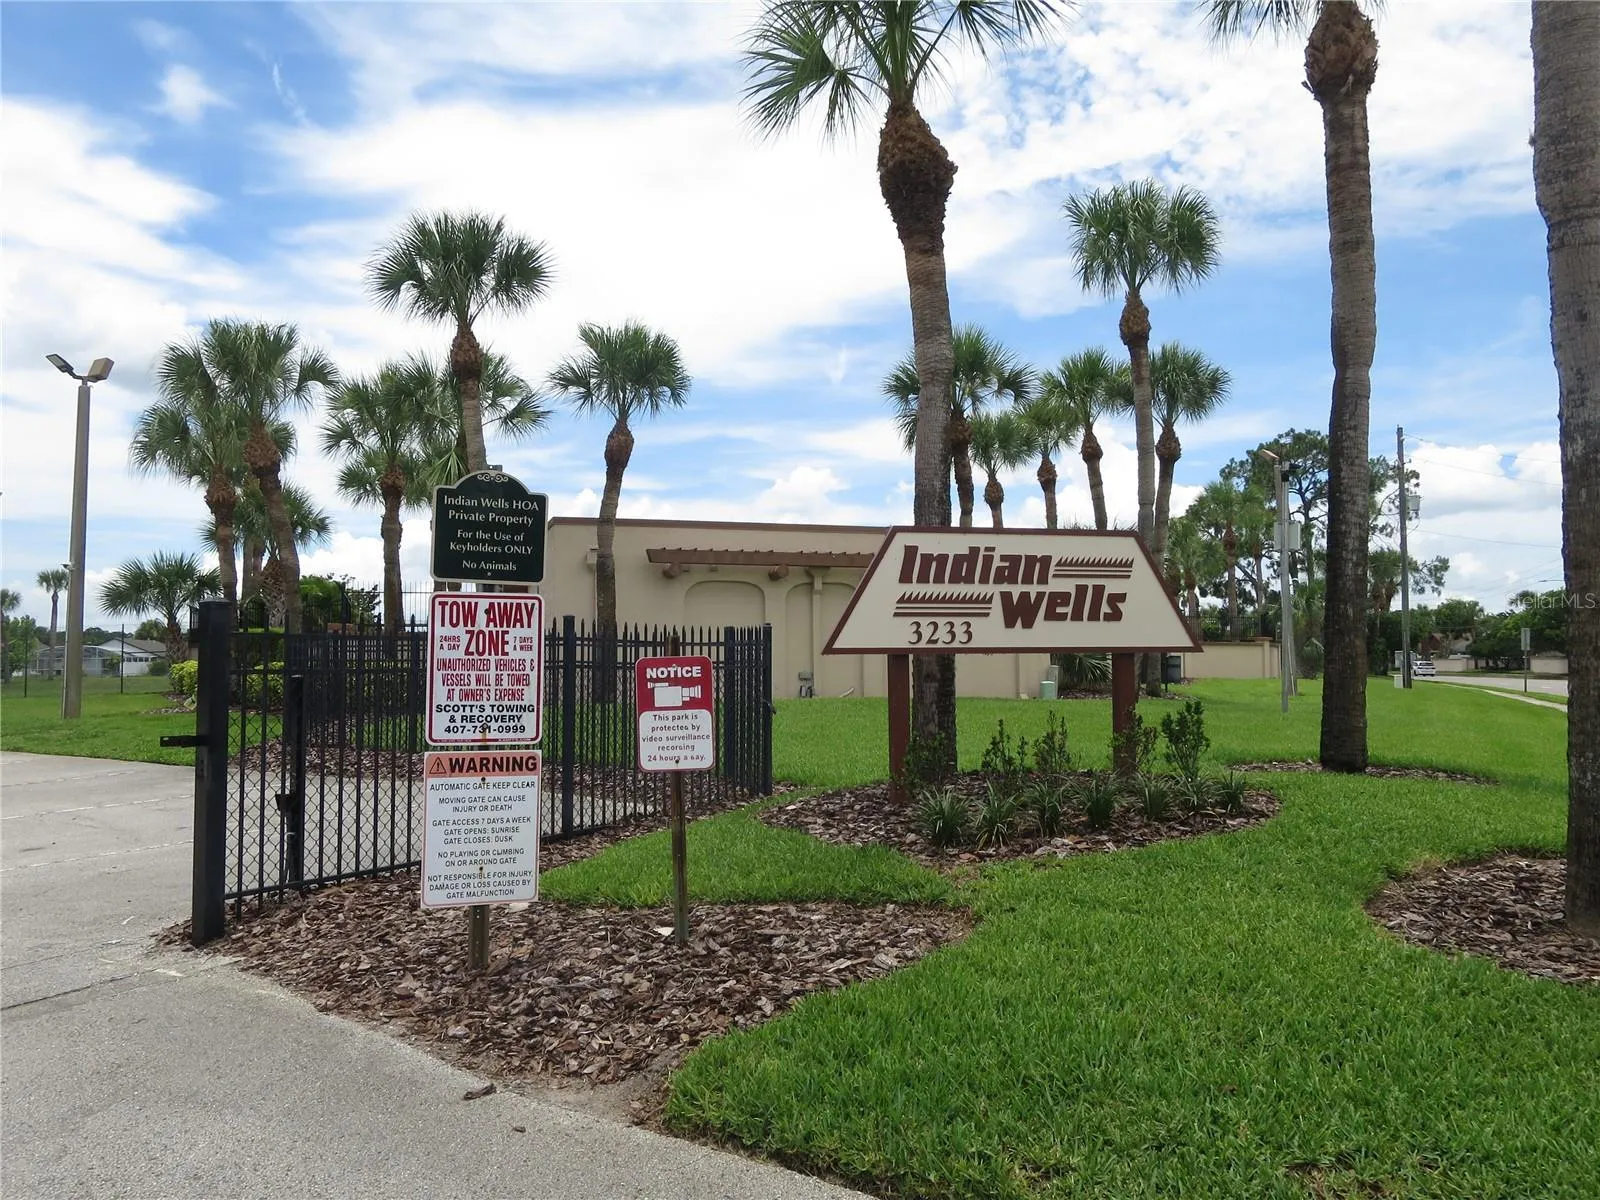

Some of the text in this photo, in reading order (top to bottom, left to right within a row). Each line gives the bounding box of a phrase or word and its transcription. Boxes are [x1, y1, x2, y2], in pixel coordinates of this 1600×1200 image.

[444, 495, 539, 510] Indian Wells HOA
[448, 510, 533, 526] Private Property
[457, 530, 524, 541] For the Use of
[450, 542, 533, 554] Keyholders ONLY
[463, 560, 516, 571] No Animals
[898, 545, 1052, 585] Indian
[999, 584, 1126, 629] Wells
[438, 601, 535, 628] TOW AWAY
[908, 620, 973, 645] 3233
[464, 630, 509, 656] ZONE
[436, 658, 534, 671] UNAUTHORIZED VEHICLES &
[646, 666, 701, 678] NOTICE
[442, 673, 530, 686] VESSELS WILL BE TOWED
[447, 689, 525, 701] AT OWNER'S EXPENSE
[436, 704, 535, 713] SCOTT'S TOWING
[461, 715, 523, 723] RECOVERY
[449, 756, 537, 773] WARNING
[430, 782, 470, 791] AUTOMATIC
[444, 872, 492, 882] RESPONSIBLE
[430, 883, 459, 891] DAMAGE
[466, 888, 514, 897] MALFUNCTION
